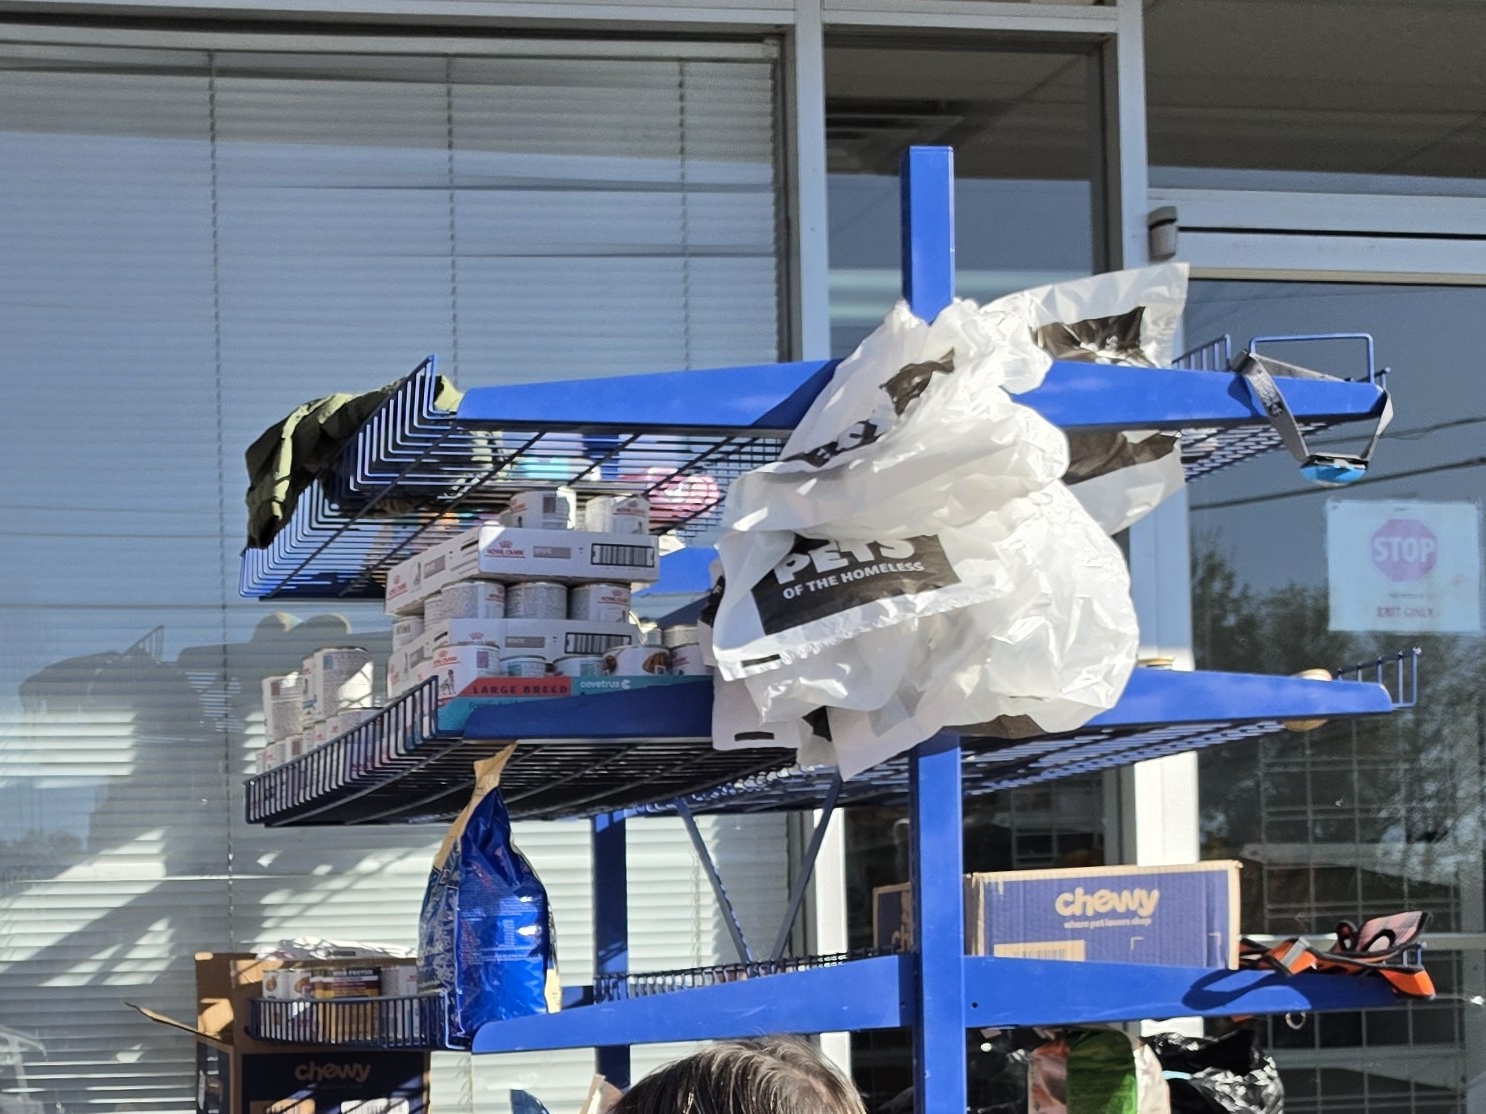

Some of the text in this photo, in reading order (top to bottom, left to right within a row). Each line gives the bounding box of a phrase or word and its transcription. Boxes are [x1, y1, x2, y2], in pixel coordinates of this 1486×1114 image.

[773, 538, 915, 585] PETS
[1374, 536, 1435, 563] STOP
[782, 561, 925, 600] OF THE HOMELESS
[472, 684, 568, 695] LARGE BREED
[580, 679, 619, 689] covetrus
[1055, 886, 1160, 917] chewy
[294, 1060, 371, 1083] chewy
